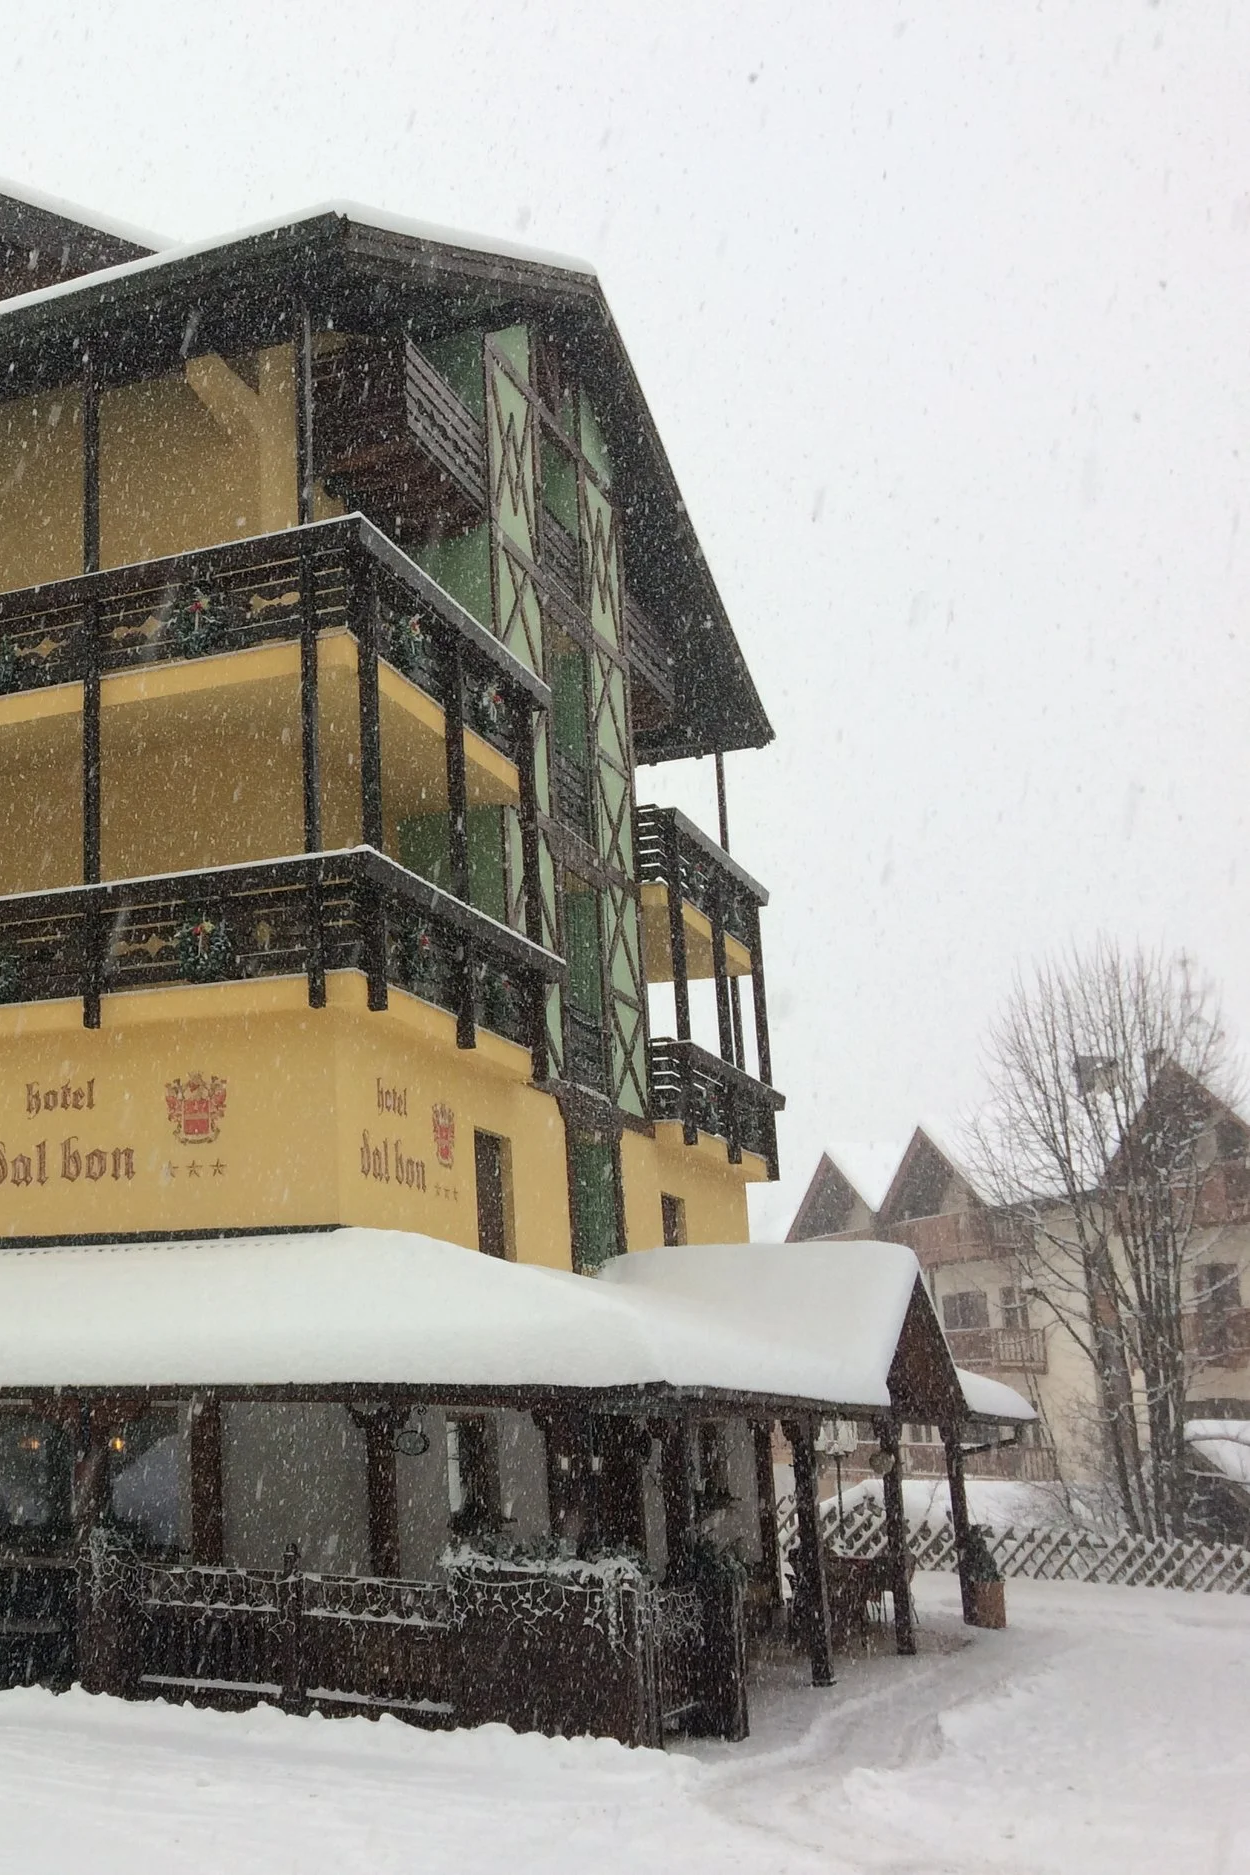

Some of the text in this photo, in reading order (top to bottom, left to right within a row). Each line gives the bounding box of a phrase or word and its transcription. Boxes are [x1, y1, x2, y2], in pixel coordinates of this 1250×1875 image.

[25, 1078, 96, 1119] hotel
[376, 1077, 408, 1117] hotel
[60, 1135, 136, 1182] bon
[360, 1128, 427, 1193] dal bon
